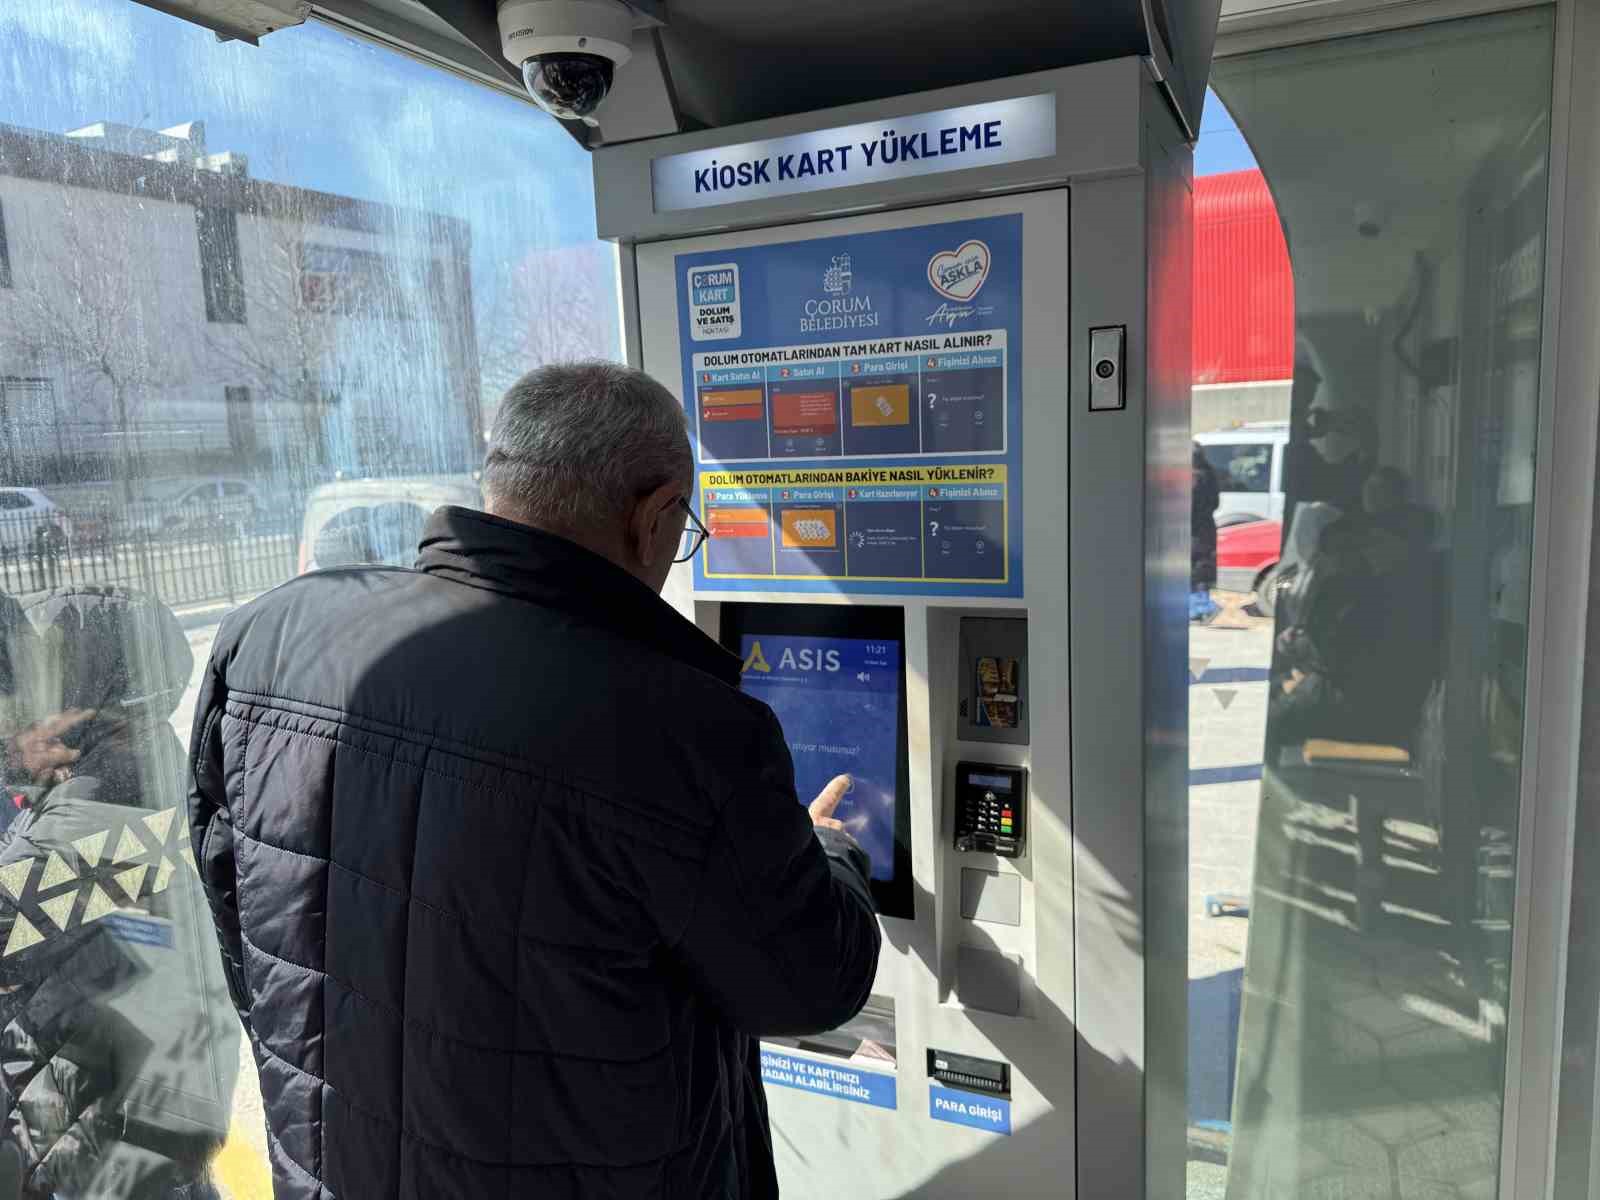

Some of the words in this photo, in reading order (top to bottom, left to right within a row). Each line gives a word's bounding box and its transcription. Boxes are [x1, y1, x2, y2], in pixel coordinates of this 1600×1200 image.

[694, 157, 771, 193] KİOSK
[777, 145, 853, 181] KART
[860, 120, 1003, 167] YÜKLEME
[699, 288, 728, 303] KART
[699, 306, 730, 317] DOLUM
[804, 297, 871, 318] ÇORUM
[697, 317, 708, 325] VE
[800, 312, 879, 332] BELEDİYESİ
[704, 355, 739, 367] DOLUM
[741, 345, 840, 365] OTOMATLARINDAN
[843, 343, 867, 357] TAM
[869, 340, 902, 355] KART
[904, 337, 940, 352] NASIL
[943, 332, 992, 349] ALINIR?
[712, 371, 729, 382] Kart
[863, 361, 884, 373] Para
[709, 474, 744, 485] DOLUM
[745, 472, 843, 484] OTOMATLARINDAN
[845, 468, 887, 483] BAKİYE
[889, 470, 924, 481] NASIL
[927, 467, 994, 481] YÜKLENİR?
[717, 490, 737, 500] Para
[778, 647, 841, 672] ASIS
[760, 1055, 791, 1071] ŞİNİZİ
[792, 1062, 806, 1072] VE
[807, 1064, 860, 1085] KARTINIZI
[795, 1074, 871, 1099] ALABİLİRSİNİZ
[935, 1098, 967, 1115] PARA
[968, 1104, 1004, 1124] GİRİŞİ
